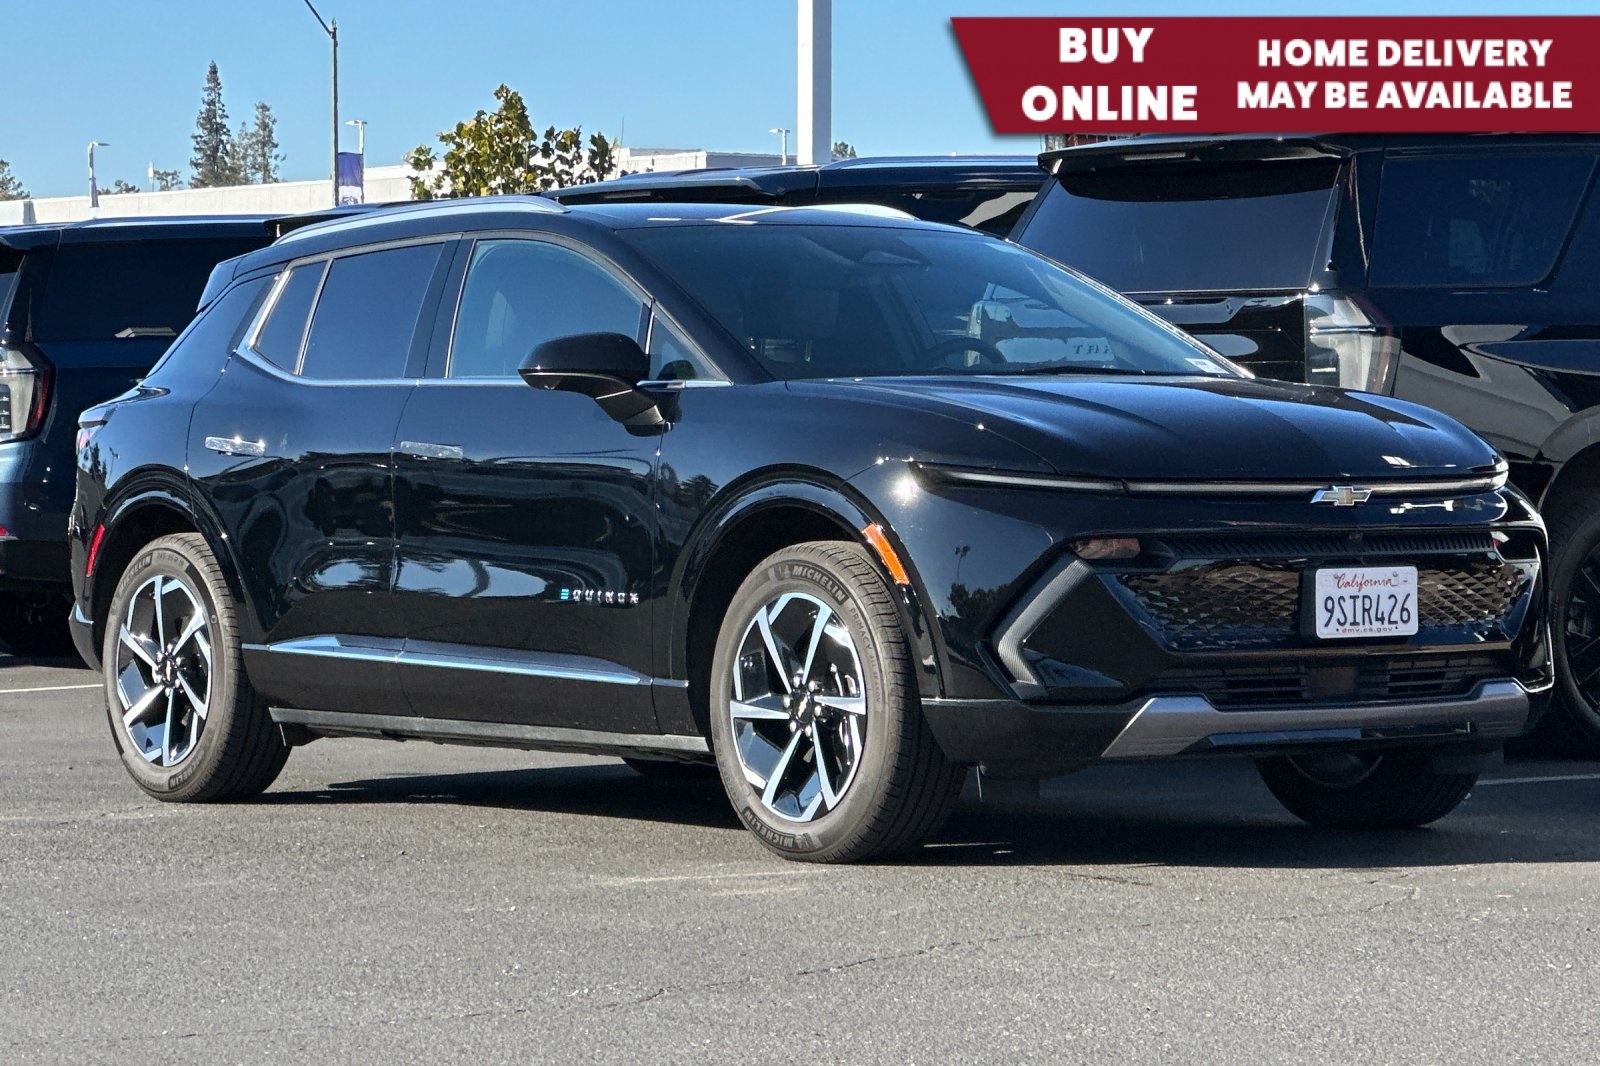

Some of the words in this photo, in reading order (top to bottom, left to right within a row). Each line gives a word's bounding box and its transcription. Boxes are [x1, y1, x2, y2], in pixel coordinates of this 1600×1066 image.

[792, 565, 847, 602] MICHELIN
[1336, 572, 1398, 592] California
[1324, 592, 1412, 627] 9SIR426
[850, 607, 873, 652] PRIMACY
[743, 810, 794, 848] MICHELIN
